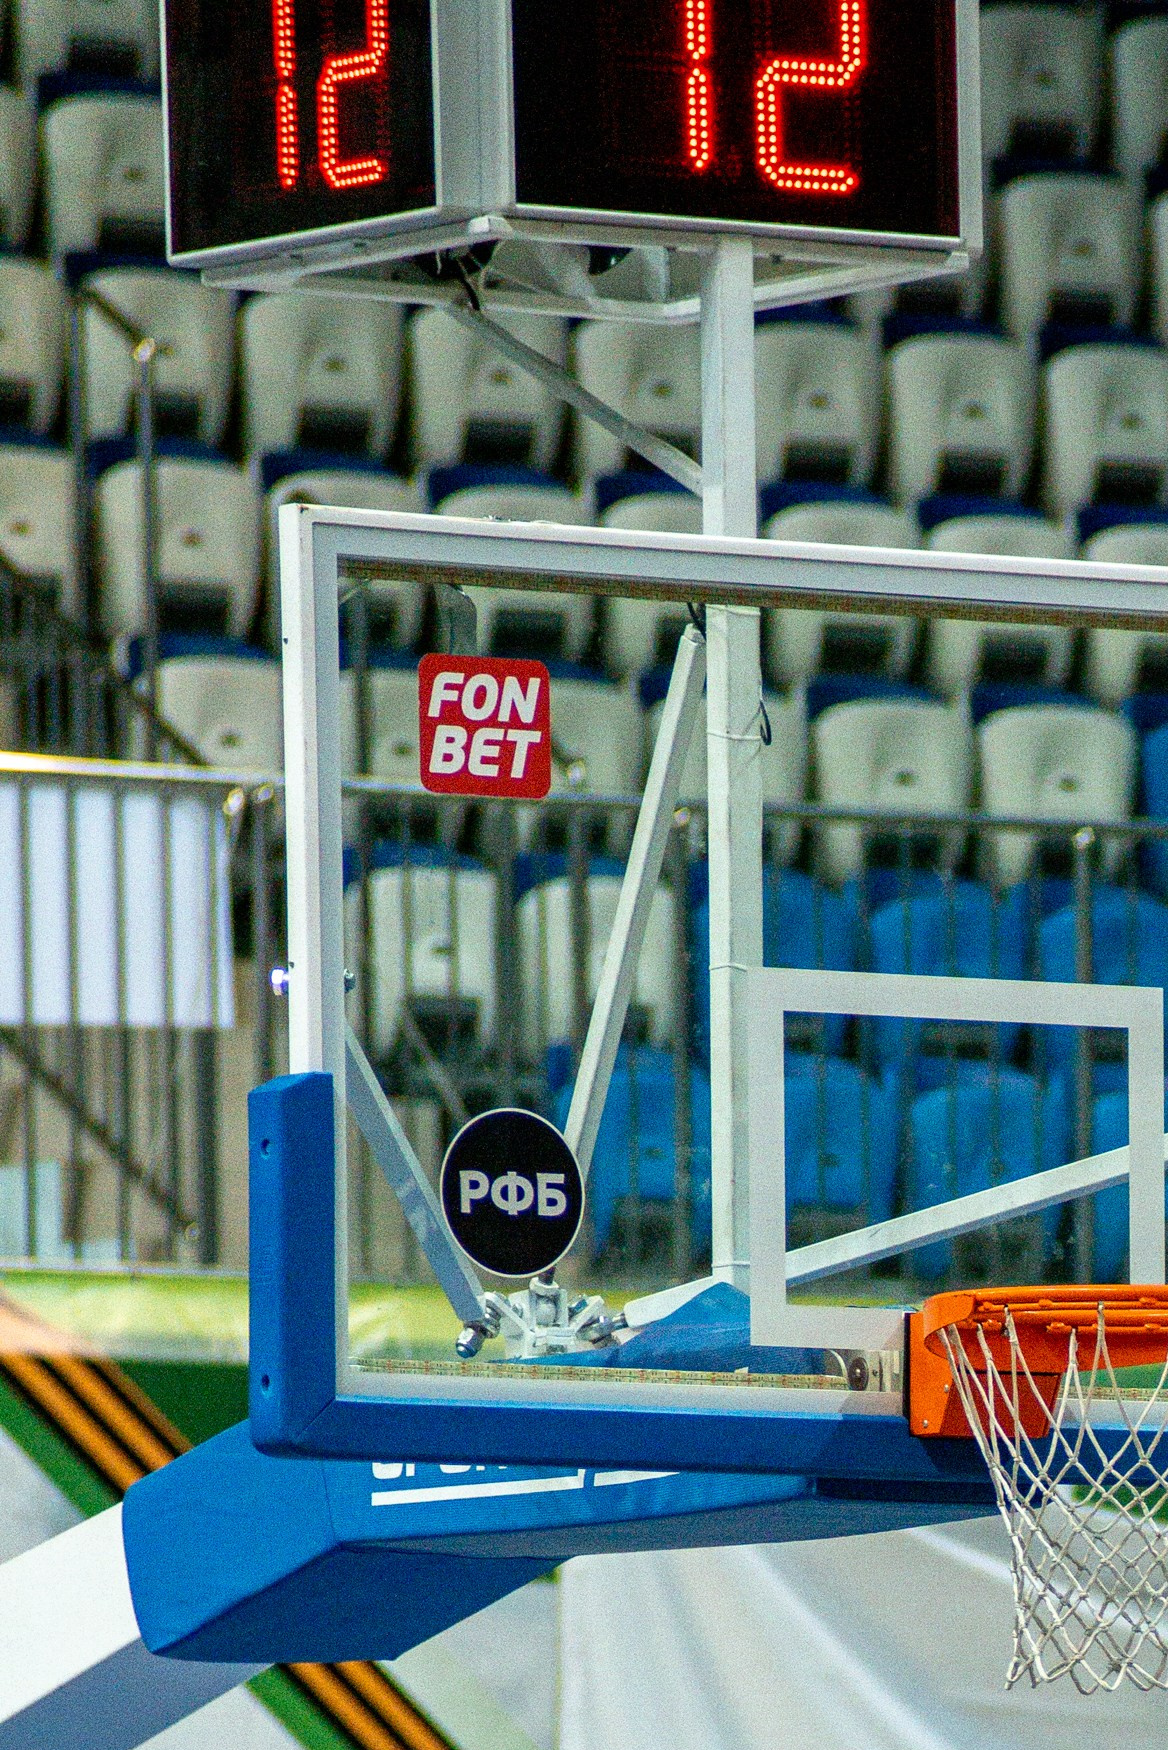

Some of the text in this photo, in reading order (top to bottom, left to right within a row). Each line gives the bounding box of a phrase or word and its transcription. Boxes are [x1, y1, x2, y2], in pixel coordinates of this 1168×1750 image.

[684, 0, 858, 193] 12
[427, 671, 541, 723] FON
[428, 724, 542, 778] BET
[459, 1170, 567, 1216] РФБ
